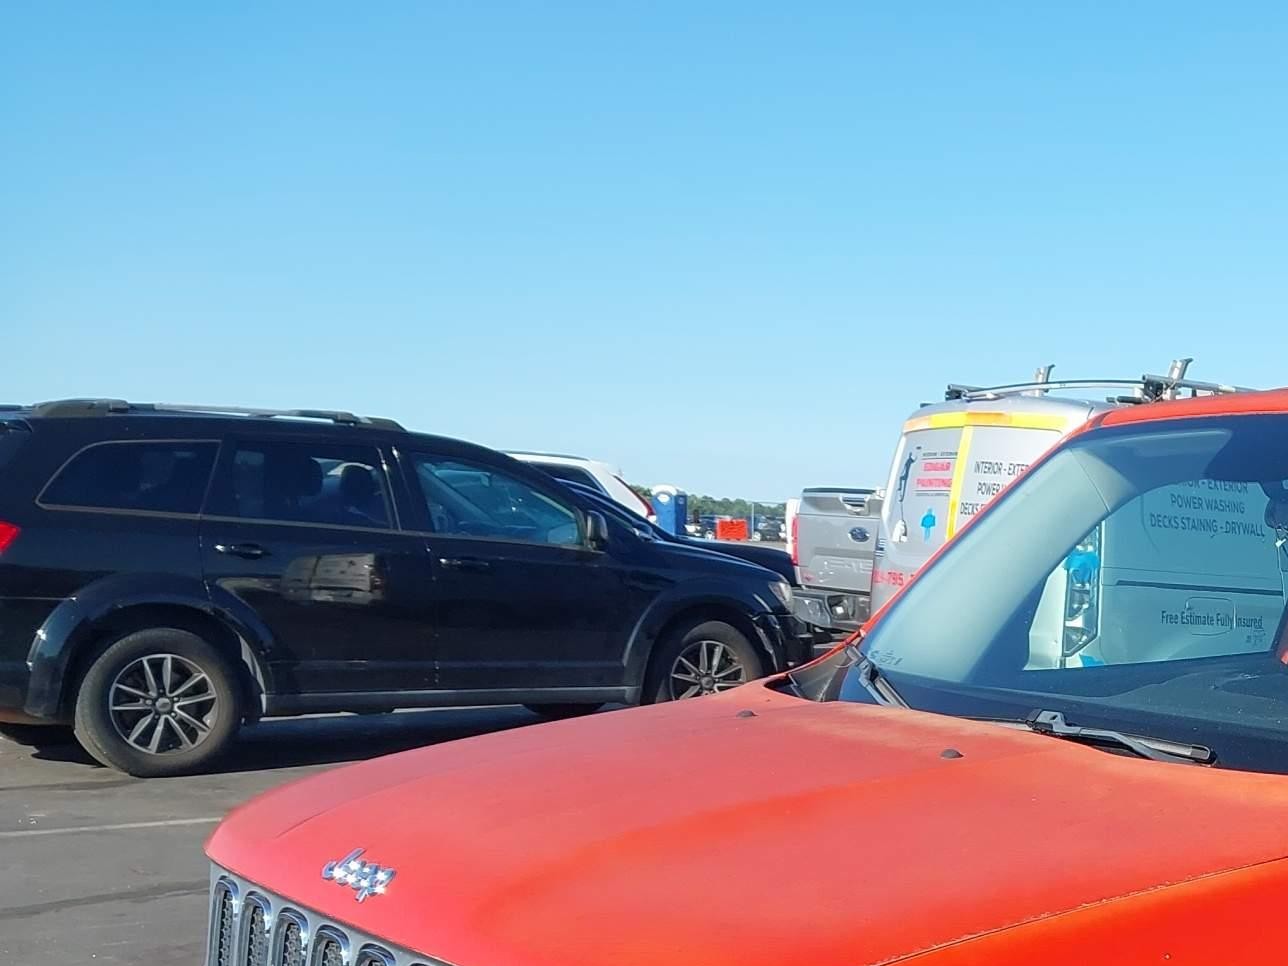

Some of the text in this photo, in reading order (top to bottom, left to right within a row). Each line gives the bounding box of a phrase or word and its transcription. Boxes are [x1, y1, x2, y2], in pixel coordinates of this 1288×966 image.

[974, 460, 1003, 475] INTERIOR
[1169, 493, 1246, 514] POWER WASHING
[1150, 512, 1180, 530] DECKS
[1224, 520, 1265, 538] DRYWALL
[1161, 610, 1264, 630] Free Estimate Fully Insured
[321, 847, 397, 904] Jeep
